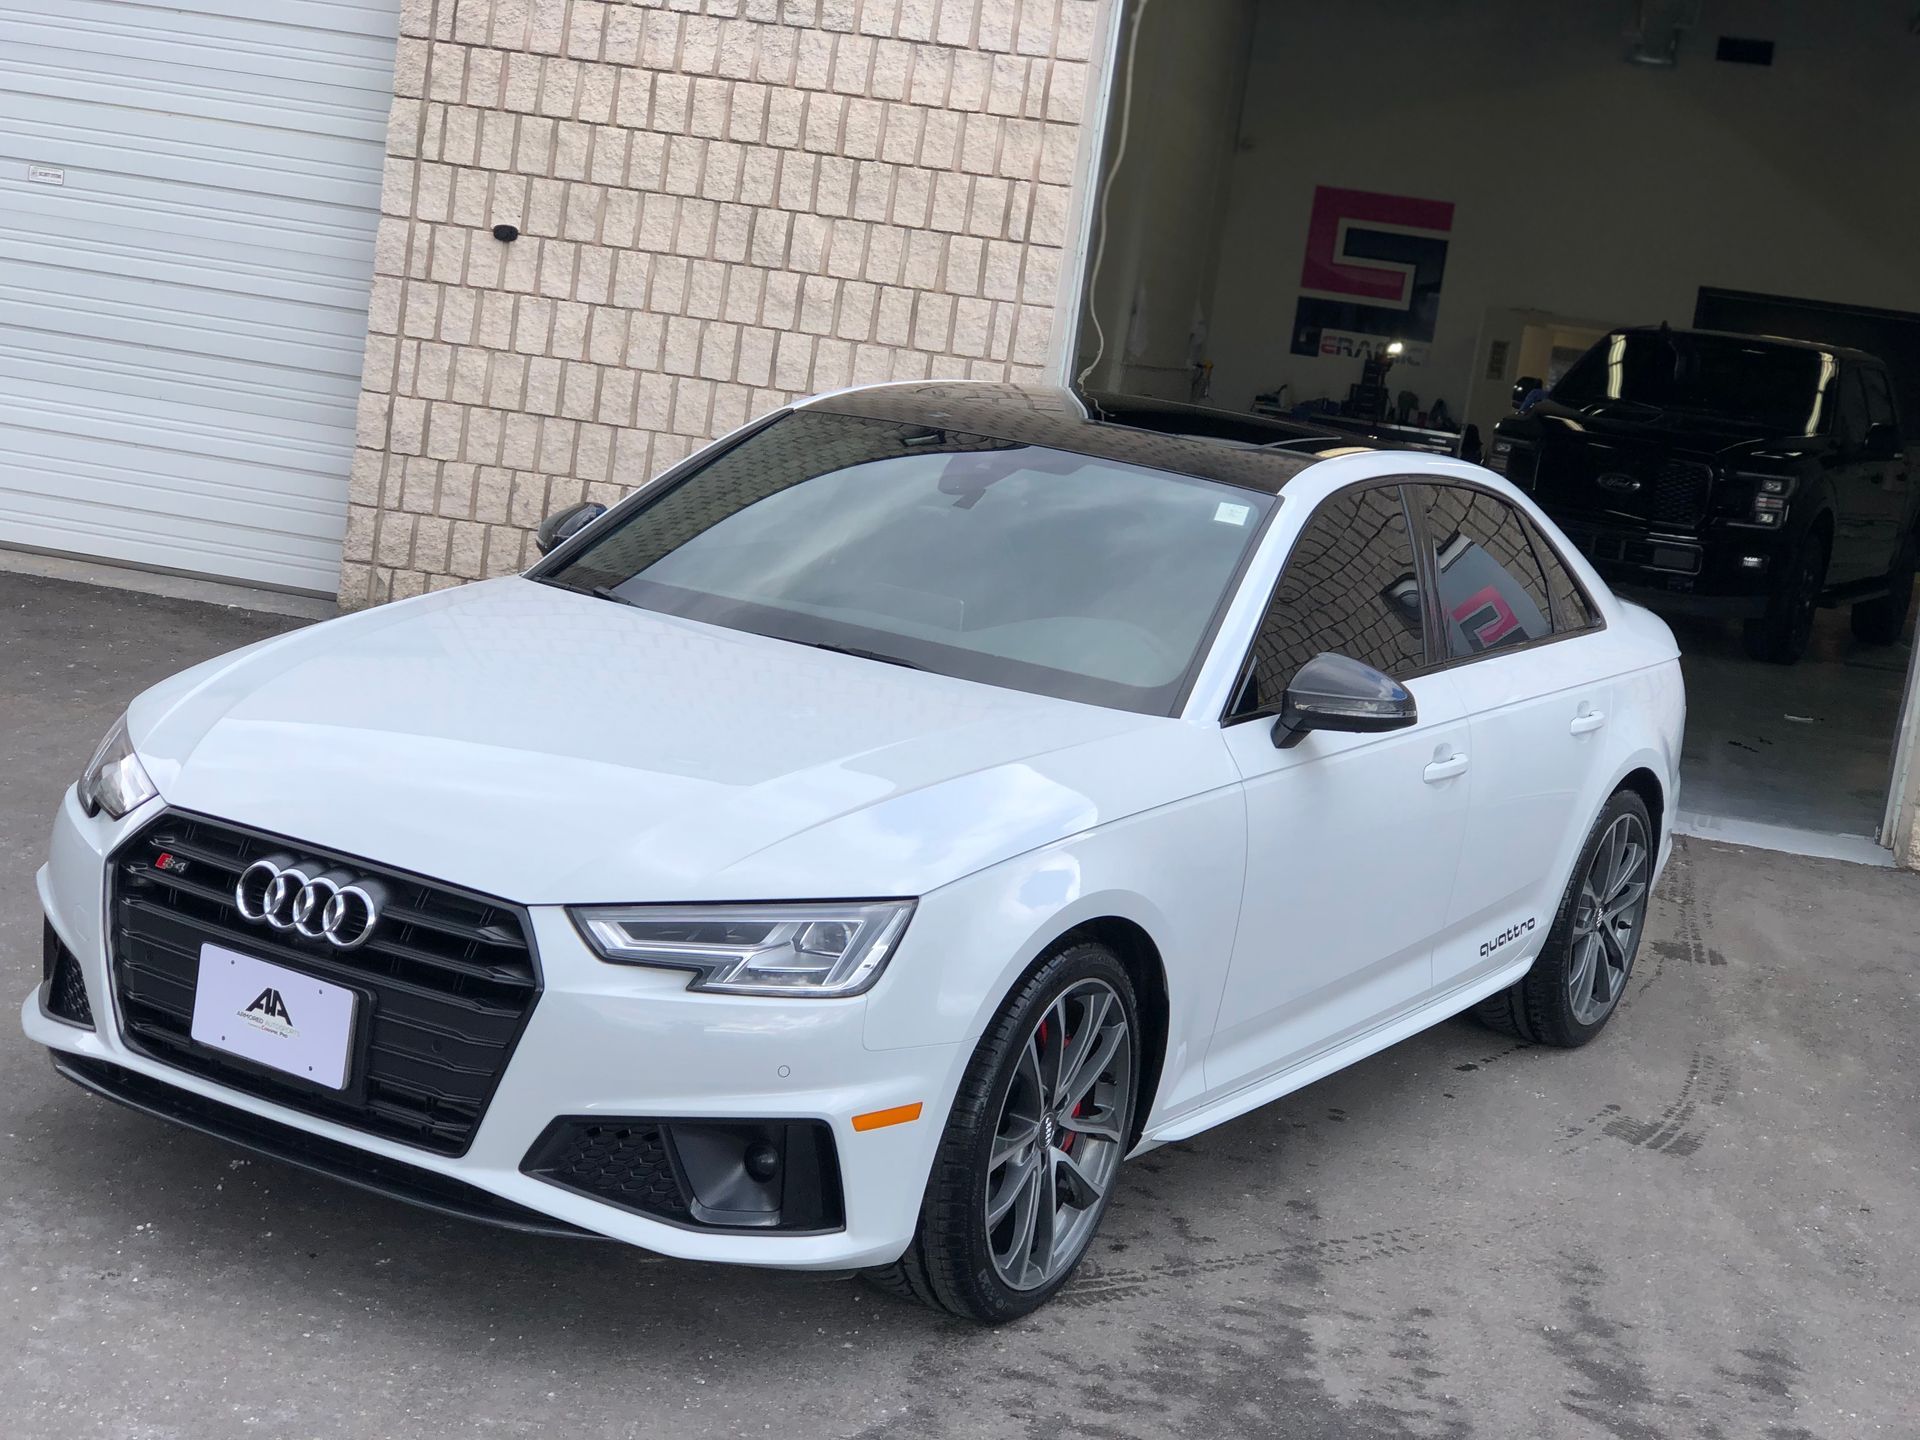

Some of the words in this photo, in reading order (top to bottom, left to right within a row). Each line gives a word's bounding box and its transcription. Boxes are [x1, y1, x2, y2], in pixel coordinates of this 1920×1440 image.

[161, 856, 186, 873] S4
[1480, 917, 1536, 957] quattro
[236, 1010, 264, 1024] ARMORED
